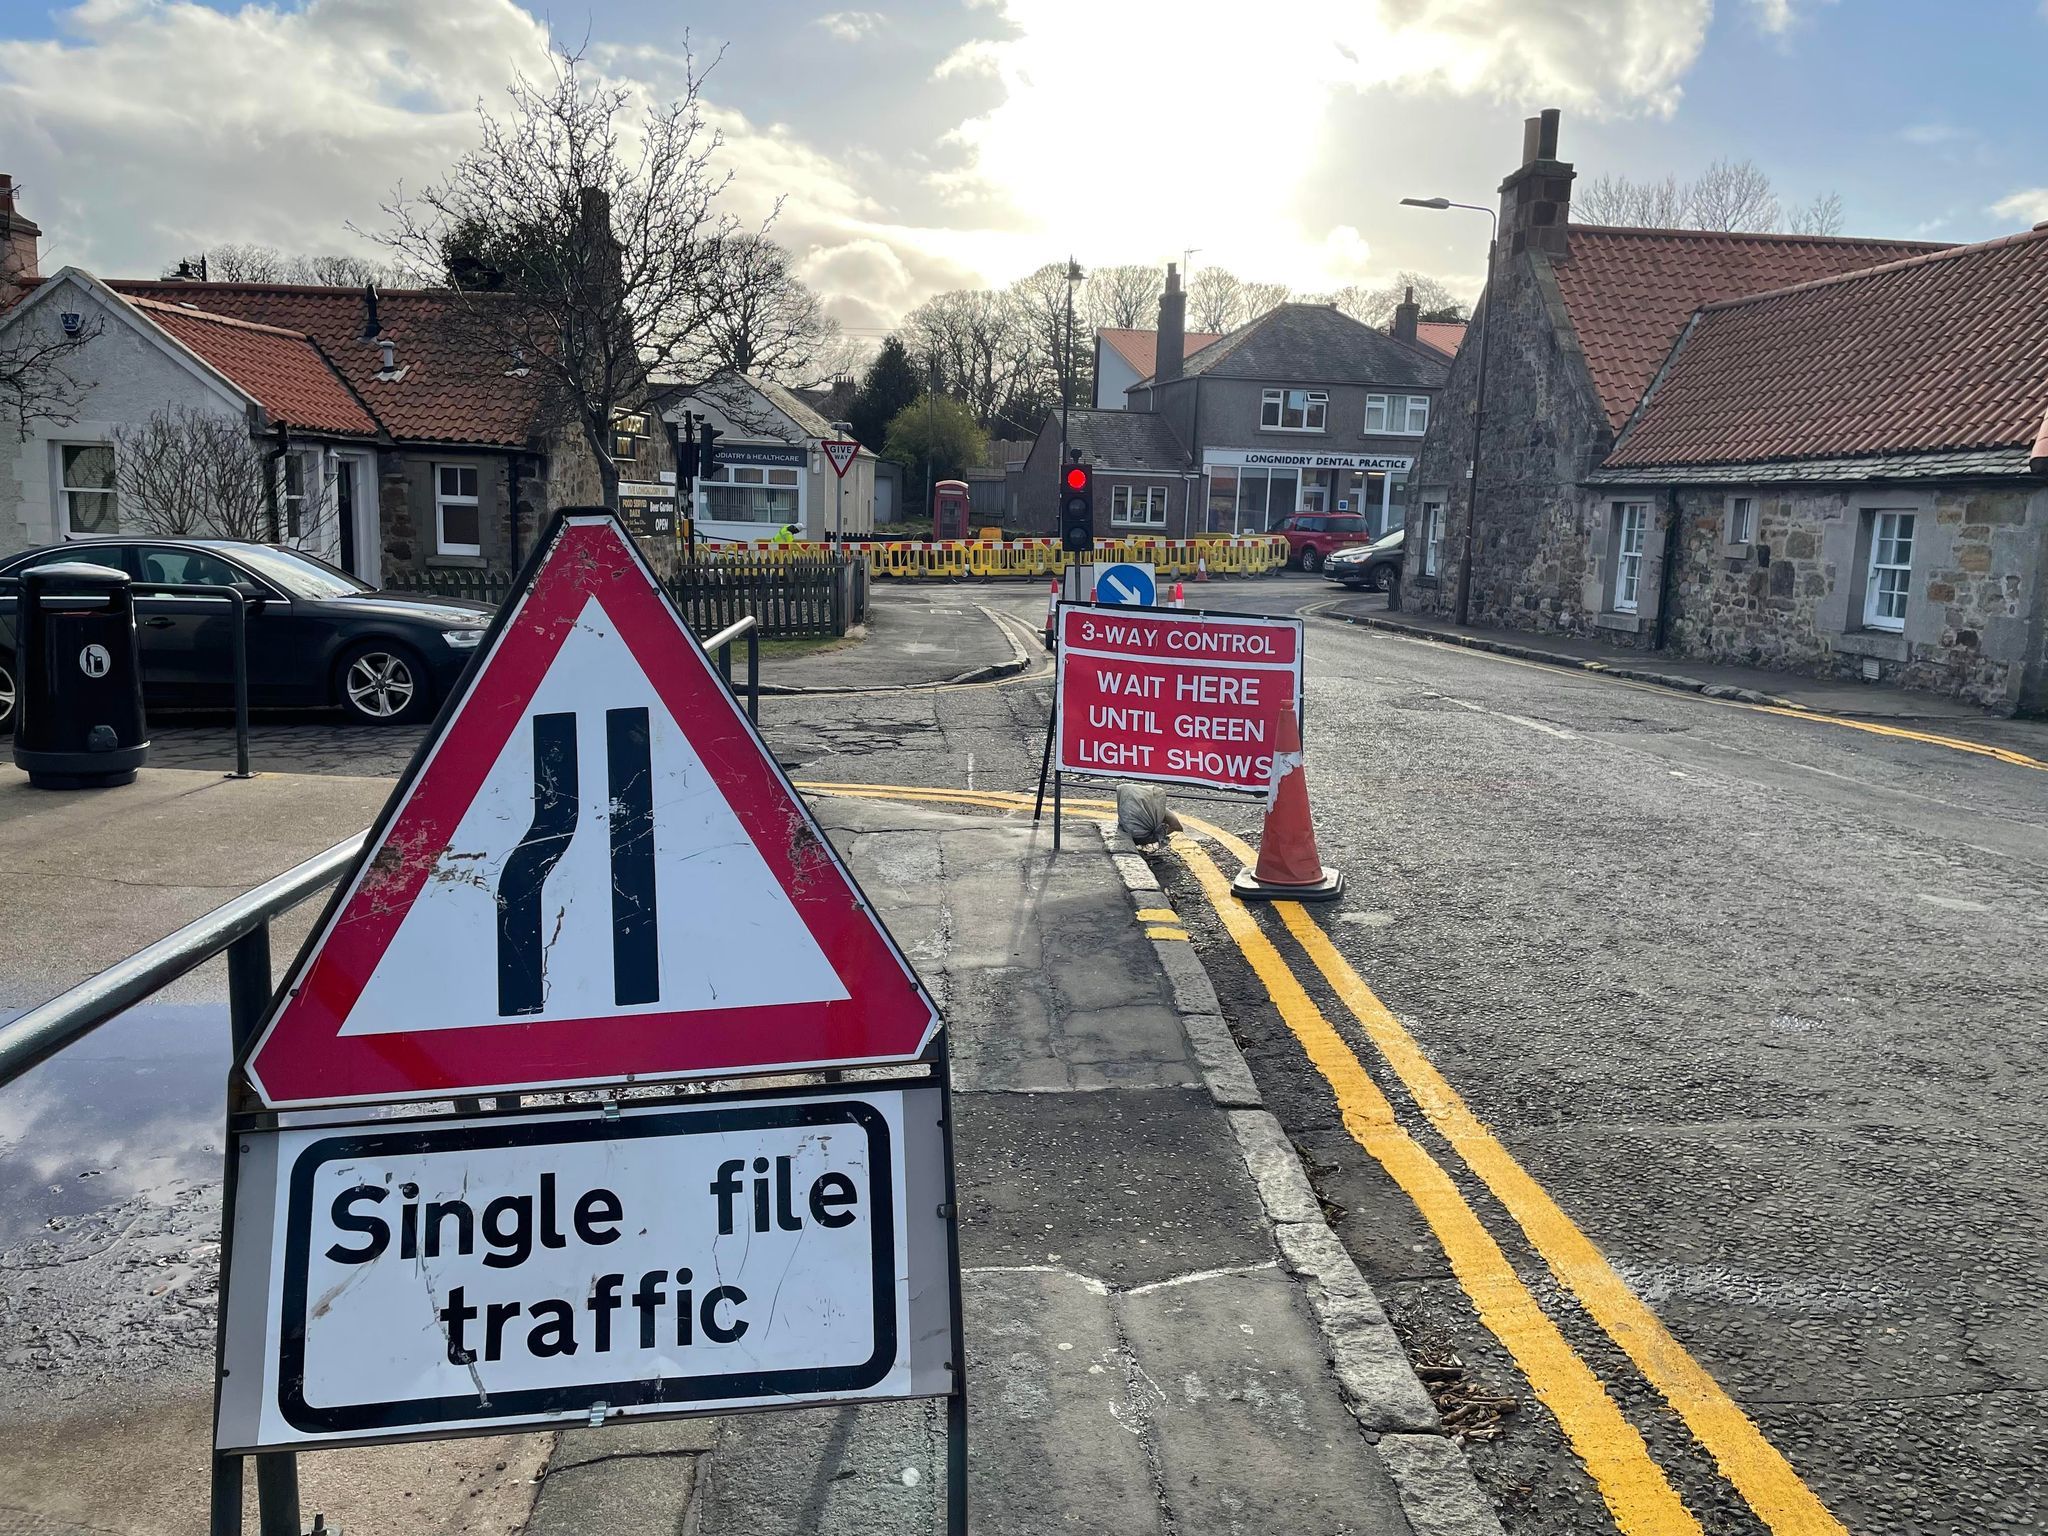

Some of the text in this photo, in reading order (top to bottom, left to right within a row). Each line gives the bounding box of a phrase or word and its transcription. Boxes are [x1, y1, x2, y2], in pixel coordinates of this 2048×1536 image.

[715, 452, 745, 460] ODIATRY
[753, 453, 800, 462] HEALTHCARE
[829, 445, 852, 454] GIVE
[1245, 454, 1407, 469] LONGNIDDRY DENTAL PRACTICE
[650, 501, 674, 512] Beer Garden
[655, 518, 669, 531] OPEN
[1081, 621, 1276, 655] 3-WAY CONTROL
[1097, 670, 1261, 706] WAIT HERE
[1089, 704, 1265, 742] UNTIL GREEN
[1079, 739, 1273, 779] LIGHT SHOWS
[324, 1155, 858, 1269] Single file
[439, 1266, 750, 1366] traffic
